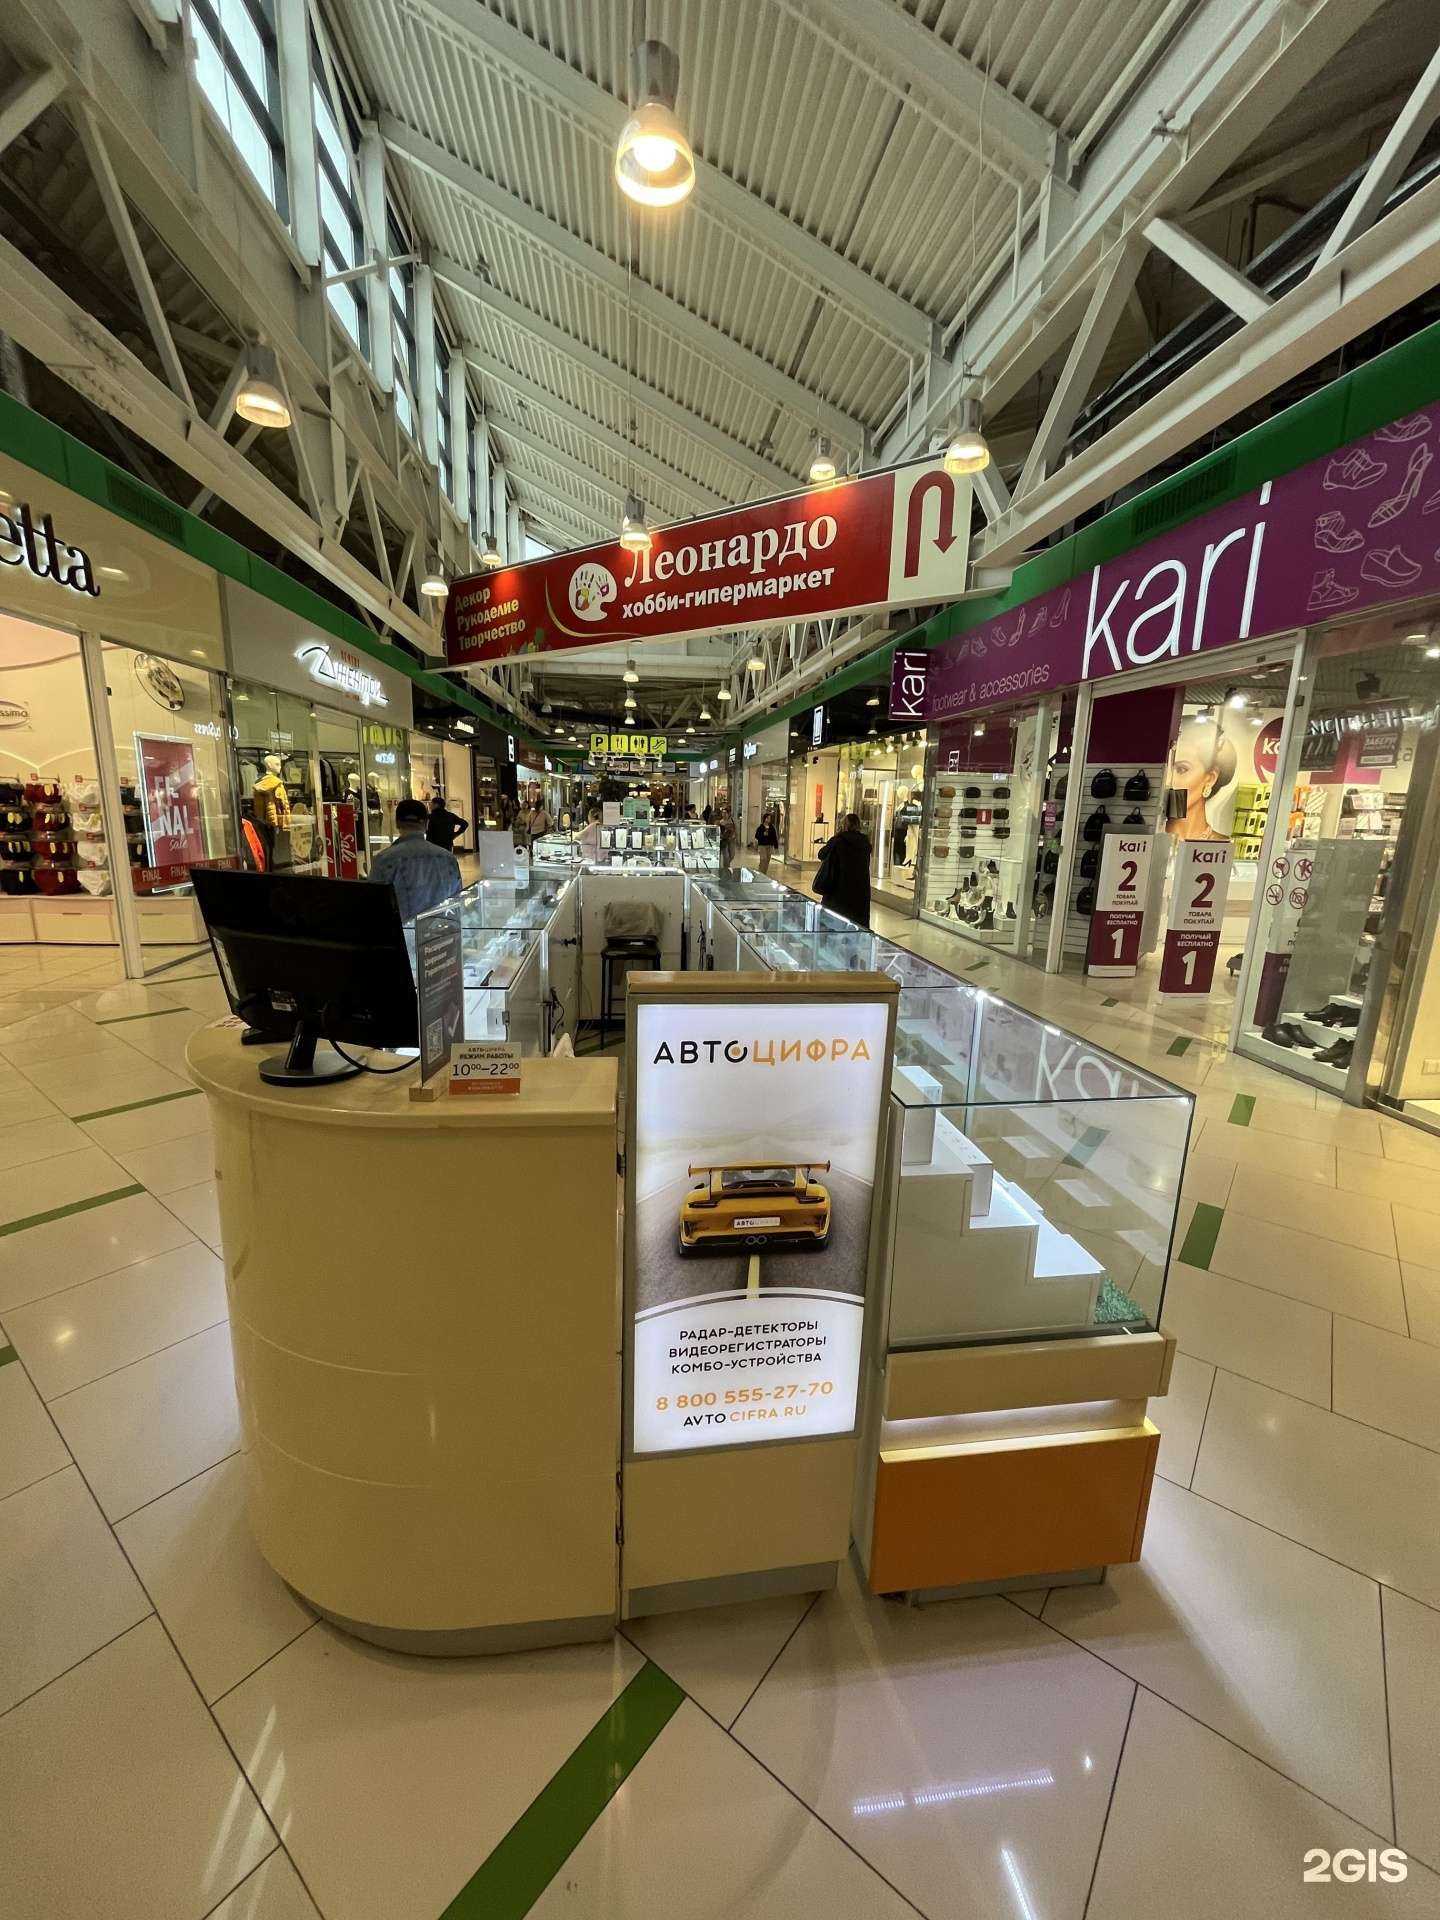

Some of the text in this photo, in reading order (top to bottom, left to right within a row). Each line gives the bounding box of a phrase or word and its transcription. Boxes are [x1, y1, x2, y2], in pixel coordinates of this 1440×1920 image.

[624, 515, 838, 587] Леонардо
[622, 567, 835, 619] хобби-гипермаркет
[1081, 481, 1272, 679] kari
[455, 587, 491, 612] Декор
[457, 599, 519, 631] Рукоделие
[458, 619, 526, 650] Творчество
[892, 652, 928, 716] kari
[969, 683, 977, 702] &
[979, 664, 1050, 701] accessories
[1119, 840, 1147, 853] kari
[1192, 849, 1227, 864] kari
[1118, 861, 1138, 891] 2
[1191, 873, 1216, 908] 2
[1111, 928, 1124, 959] 1
[1177, 940, 1214, 948] БЕСПЛАТНО
[1182, 950, 1197, 985] 1
[653, 1038, 871, 1066] АВТОЦИФРА
[680, 1321, 818, 1341] РАДАР-ДЕТЕКТОРЫ
[669, 1336, 827, 1358] ВИДЕОРЕГИСТРАТОРЫ
[672, 1352, 822, 1374] КОМБО-УСТРОЙСТВА
[656, 1381, 833, 1411] 8 800 555-27-70
